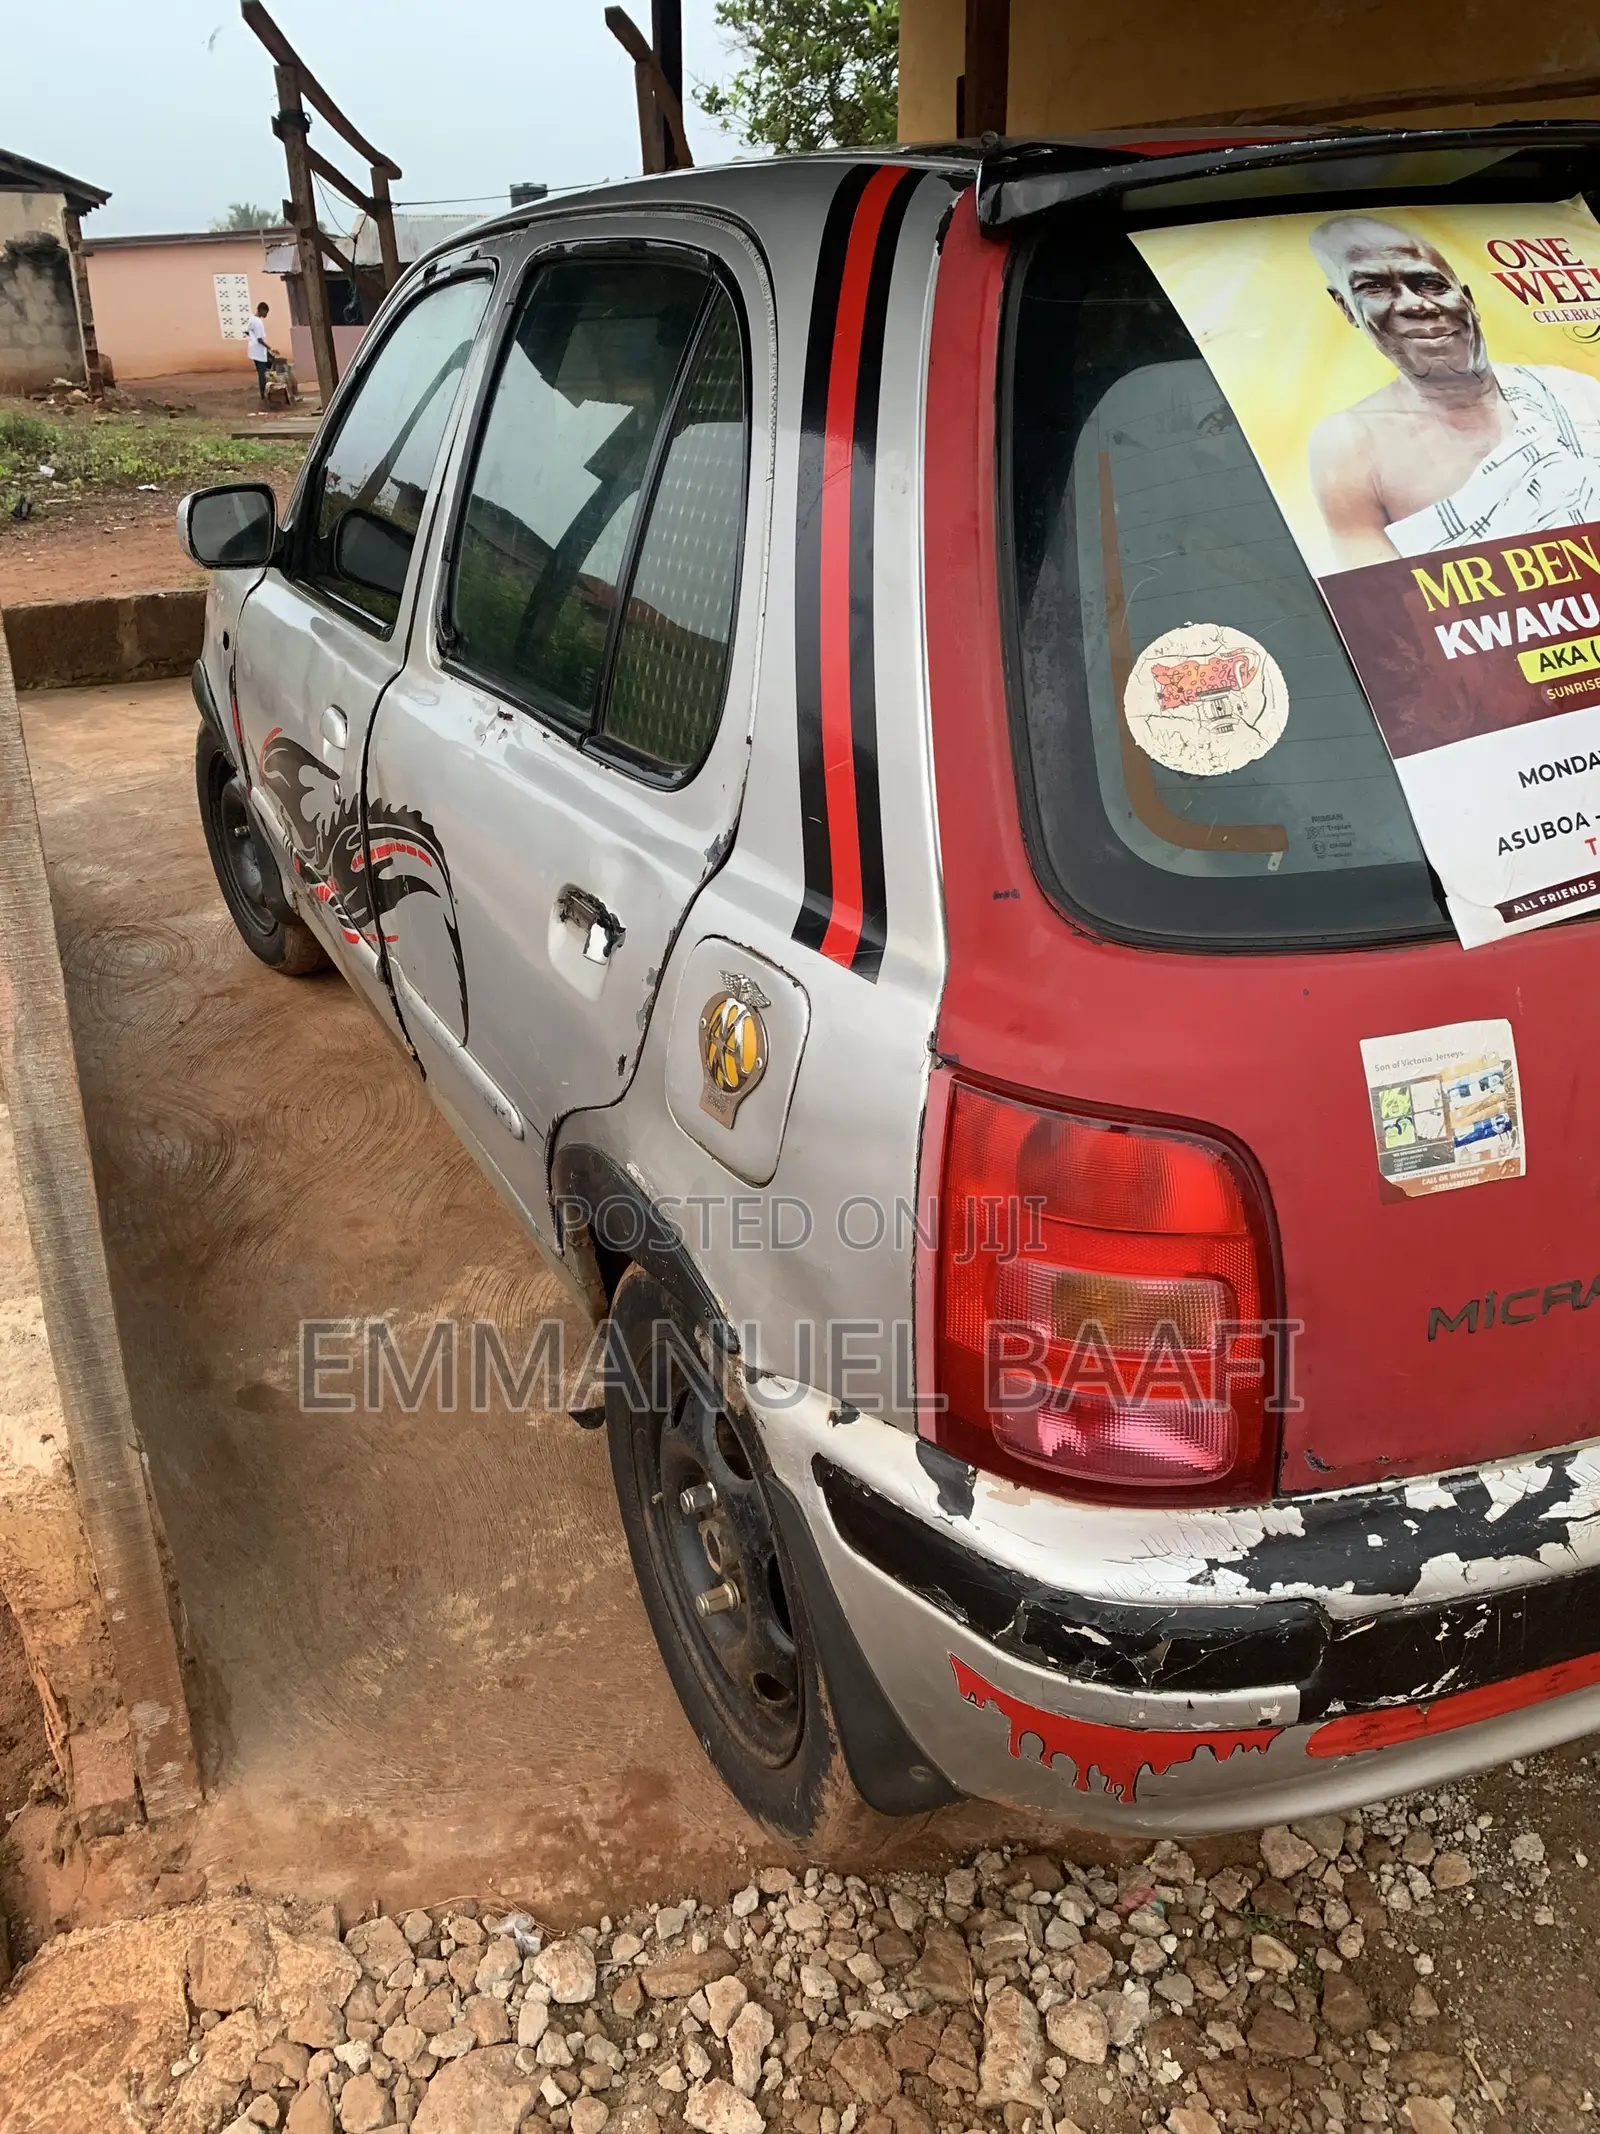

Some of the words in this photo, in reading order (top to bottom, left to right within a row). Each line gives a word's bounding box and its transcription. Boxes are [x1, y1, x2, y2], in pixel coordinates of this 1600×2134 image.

[1487, 237, 1585, 269] ONE
[1410, 556, 1506, 612] MR
[1434, 593, 1600, 659] KWAKU
[1540, 645, 1588, 672] AKA
[1518, 750, 1600, 788] MONDA
[1498, 811, 1590, 856] ASUBOA
[1513, 900, 1539, 914] ALL
[1538, 879, 1597, 905] FRIENDS
[1374, 1064, 1391, 1072] Son
[1392, 1059, 1400, 1069] of
[1401, 1055, 1433, 1067] Victoria
[1435, 1050, 1465, 1061] Jerseys
